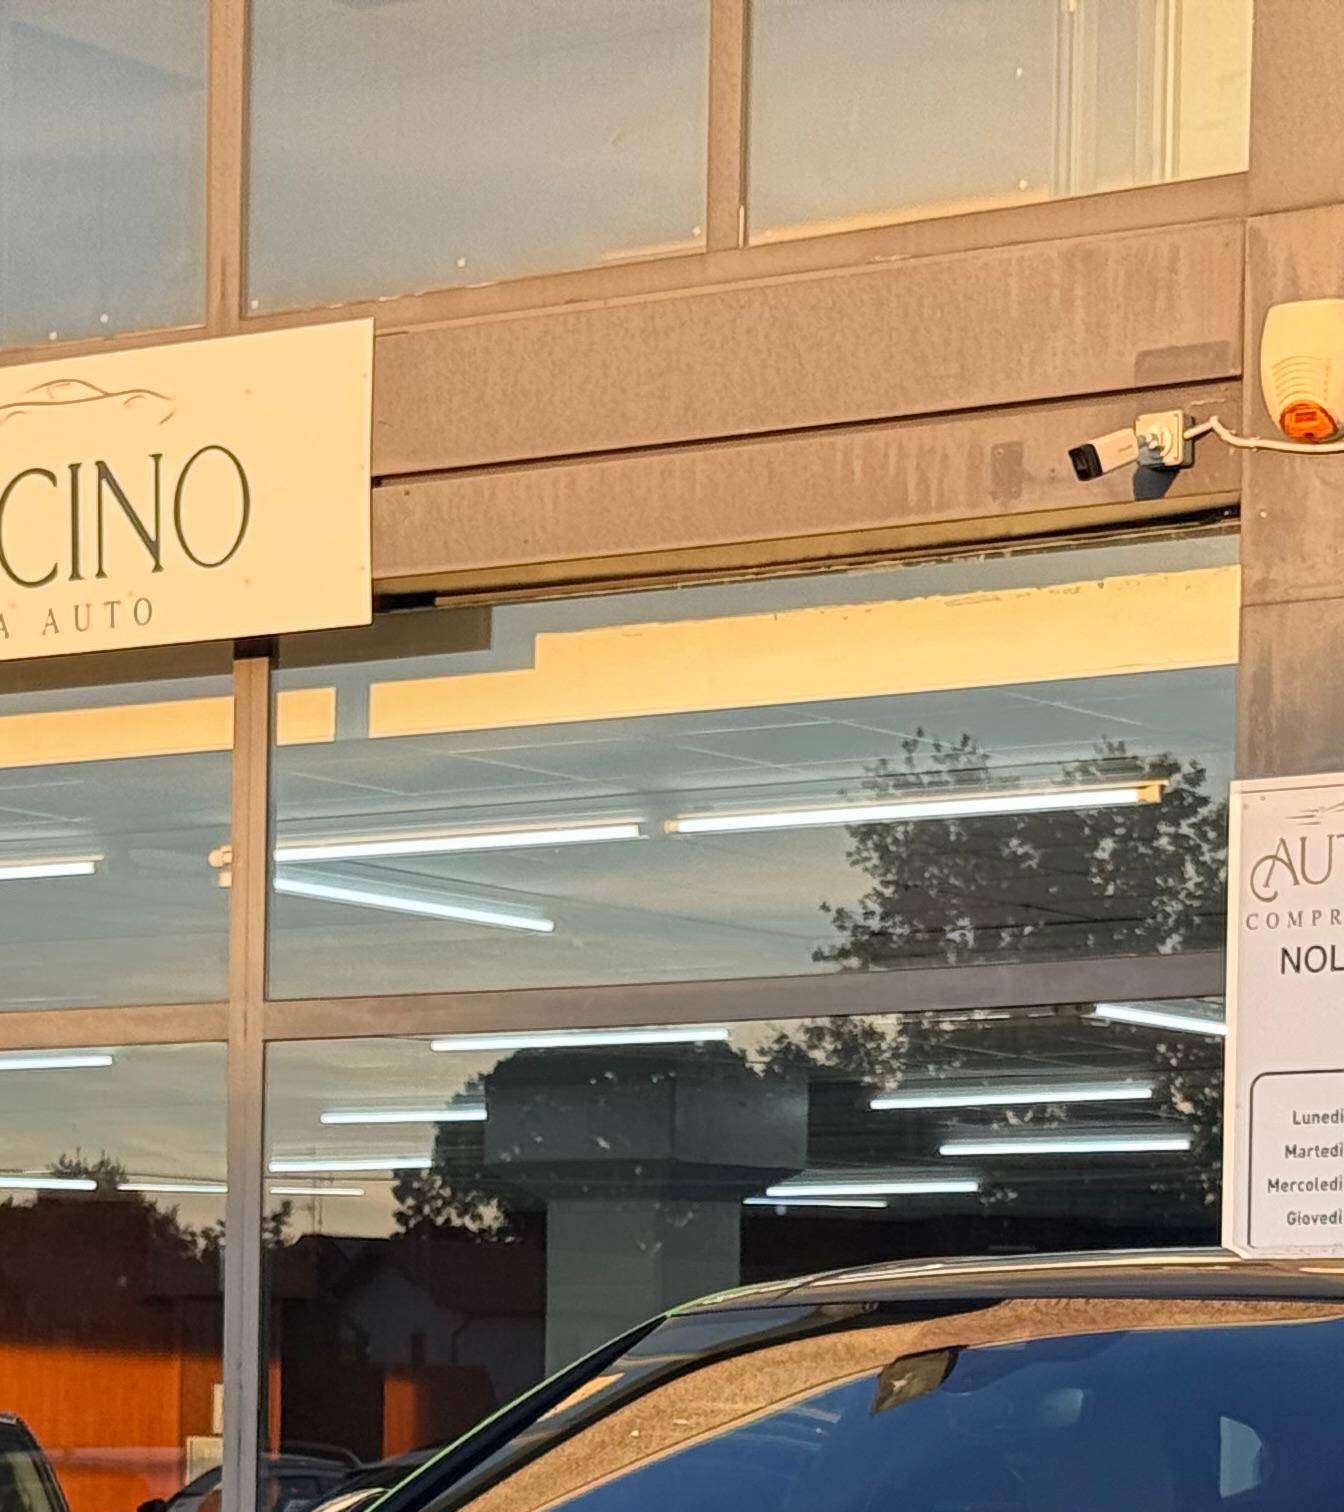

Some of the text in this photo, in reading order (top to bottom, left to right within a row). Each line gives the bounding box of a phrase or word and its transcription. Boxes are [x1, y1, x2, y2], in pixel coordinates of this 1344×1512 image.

[41, 597, 154, 637] AUTO
[1292, 1107, 1344, 1126] Lunedì
[1284, 1141, 1344, 1159] Martedì
[1267, 1176, 1344, 1194] Mercoledì
[1286, 1208, 1344, 1226] Giovedì
